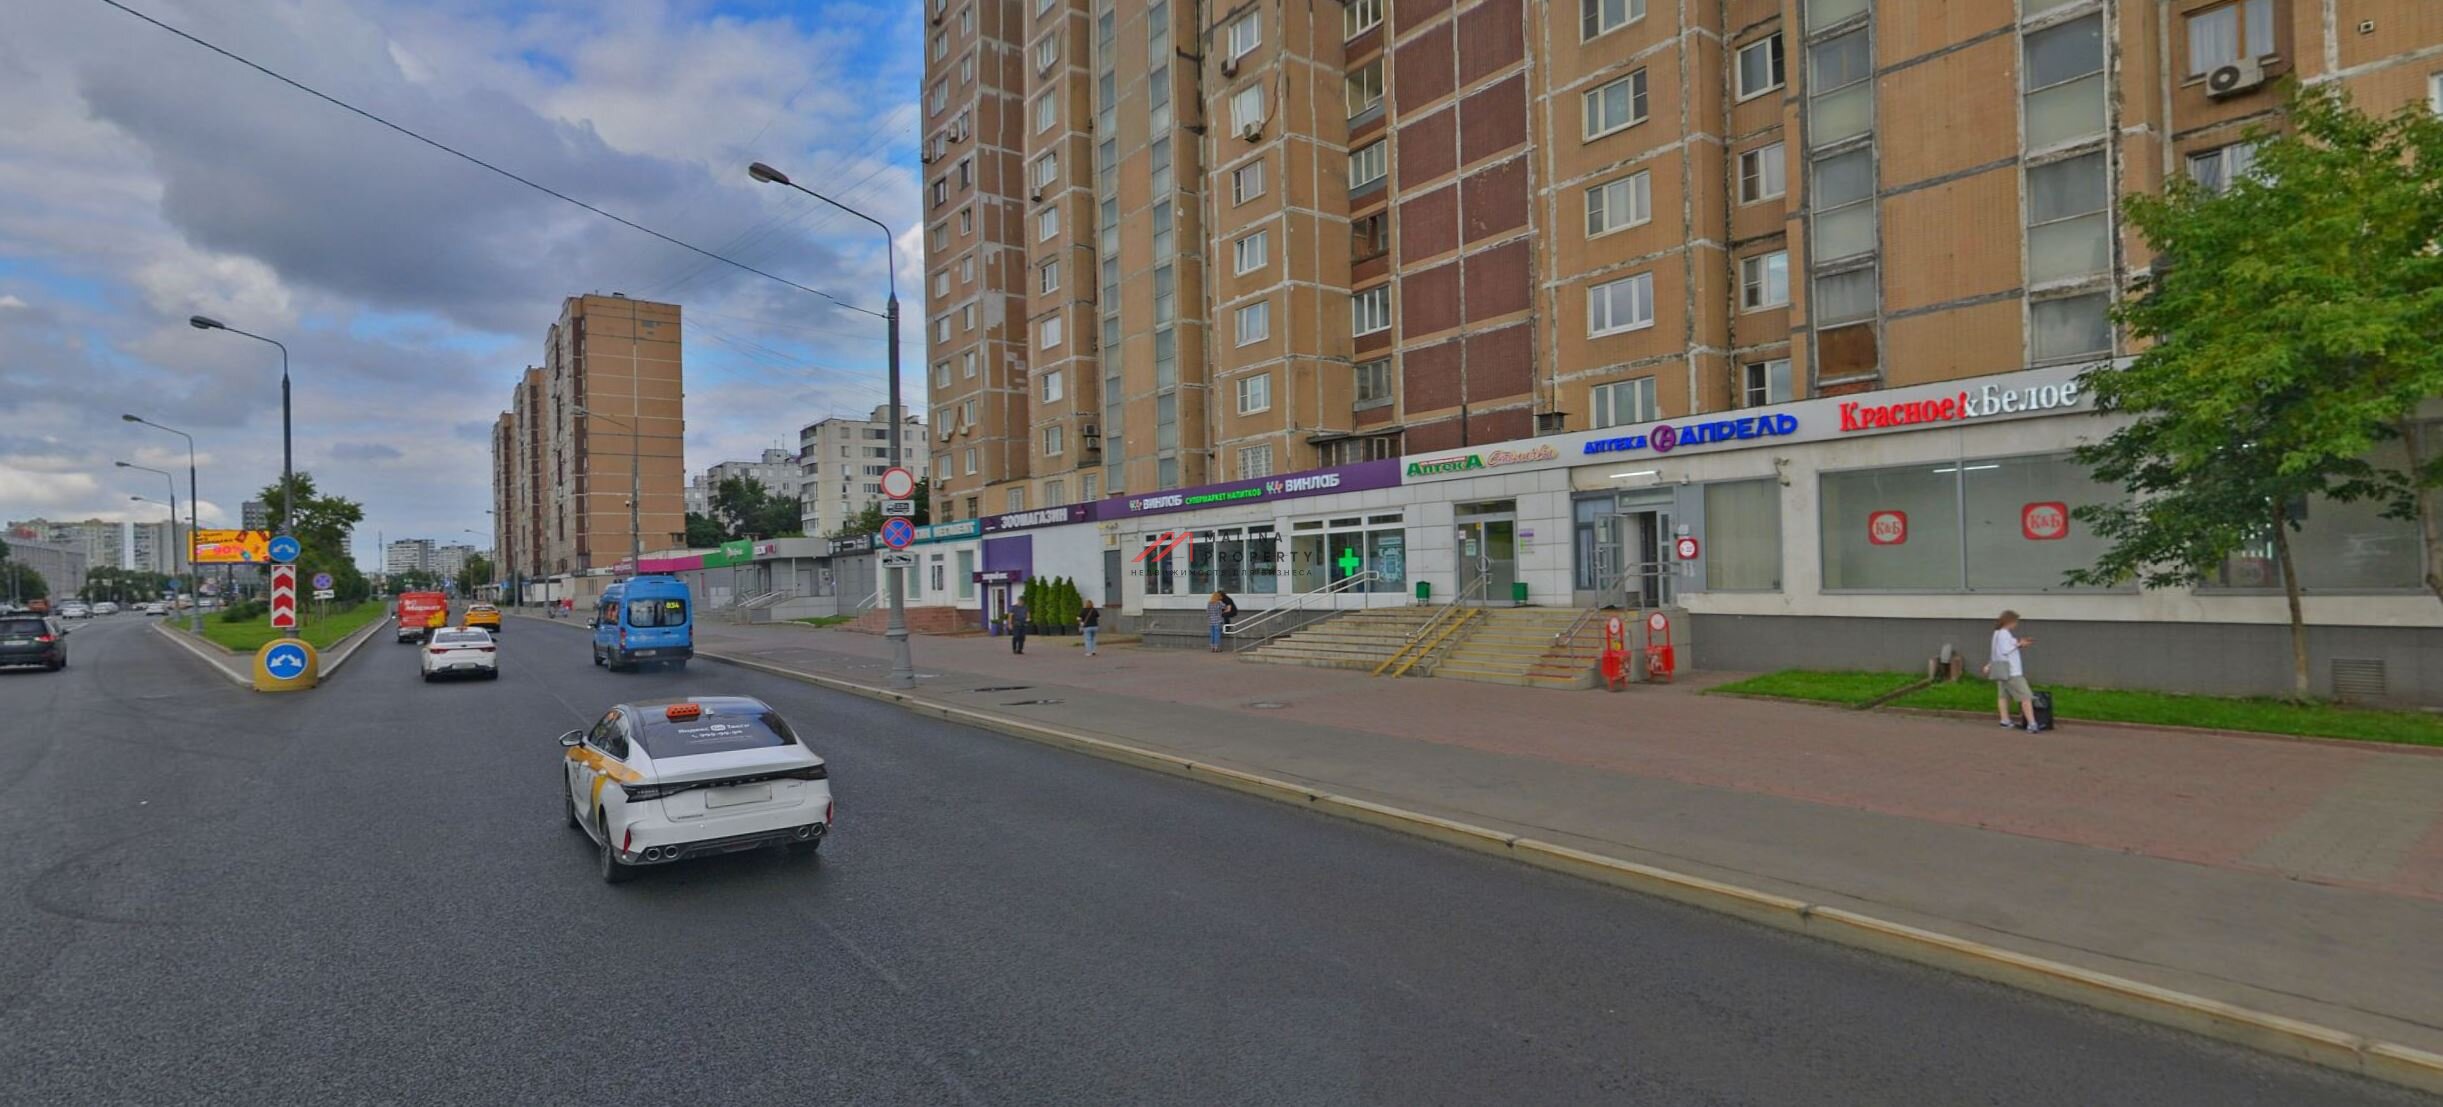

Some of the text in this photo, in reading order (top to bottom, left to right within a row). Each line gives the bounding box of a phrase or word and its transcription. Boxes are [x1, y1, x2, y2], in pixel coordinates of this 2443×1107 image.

[1583, 413, 1799, 455] АПТЕКА АПРЕЛЬ
[1185, 492, 1226, 505] СУПЕРМАРКЕТ
[1226, 488, 1262, 501] НАПИТКОВ
[1000, 507, 1068, 529] ЗООМАГАЗИН
